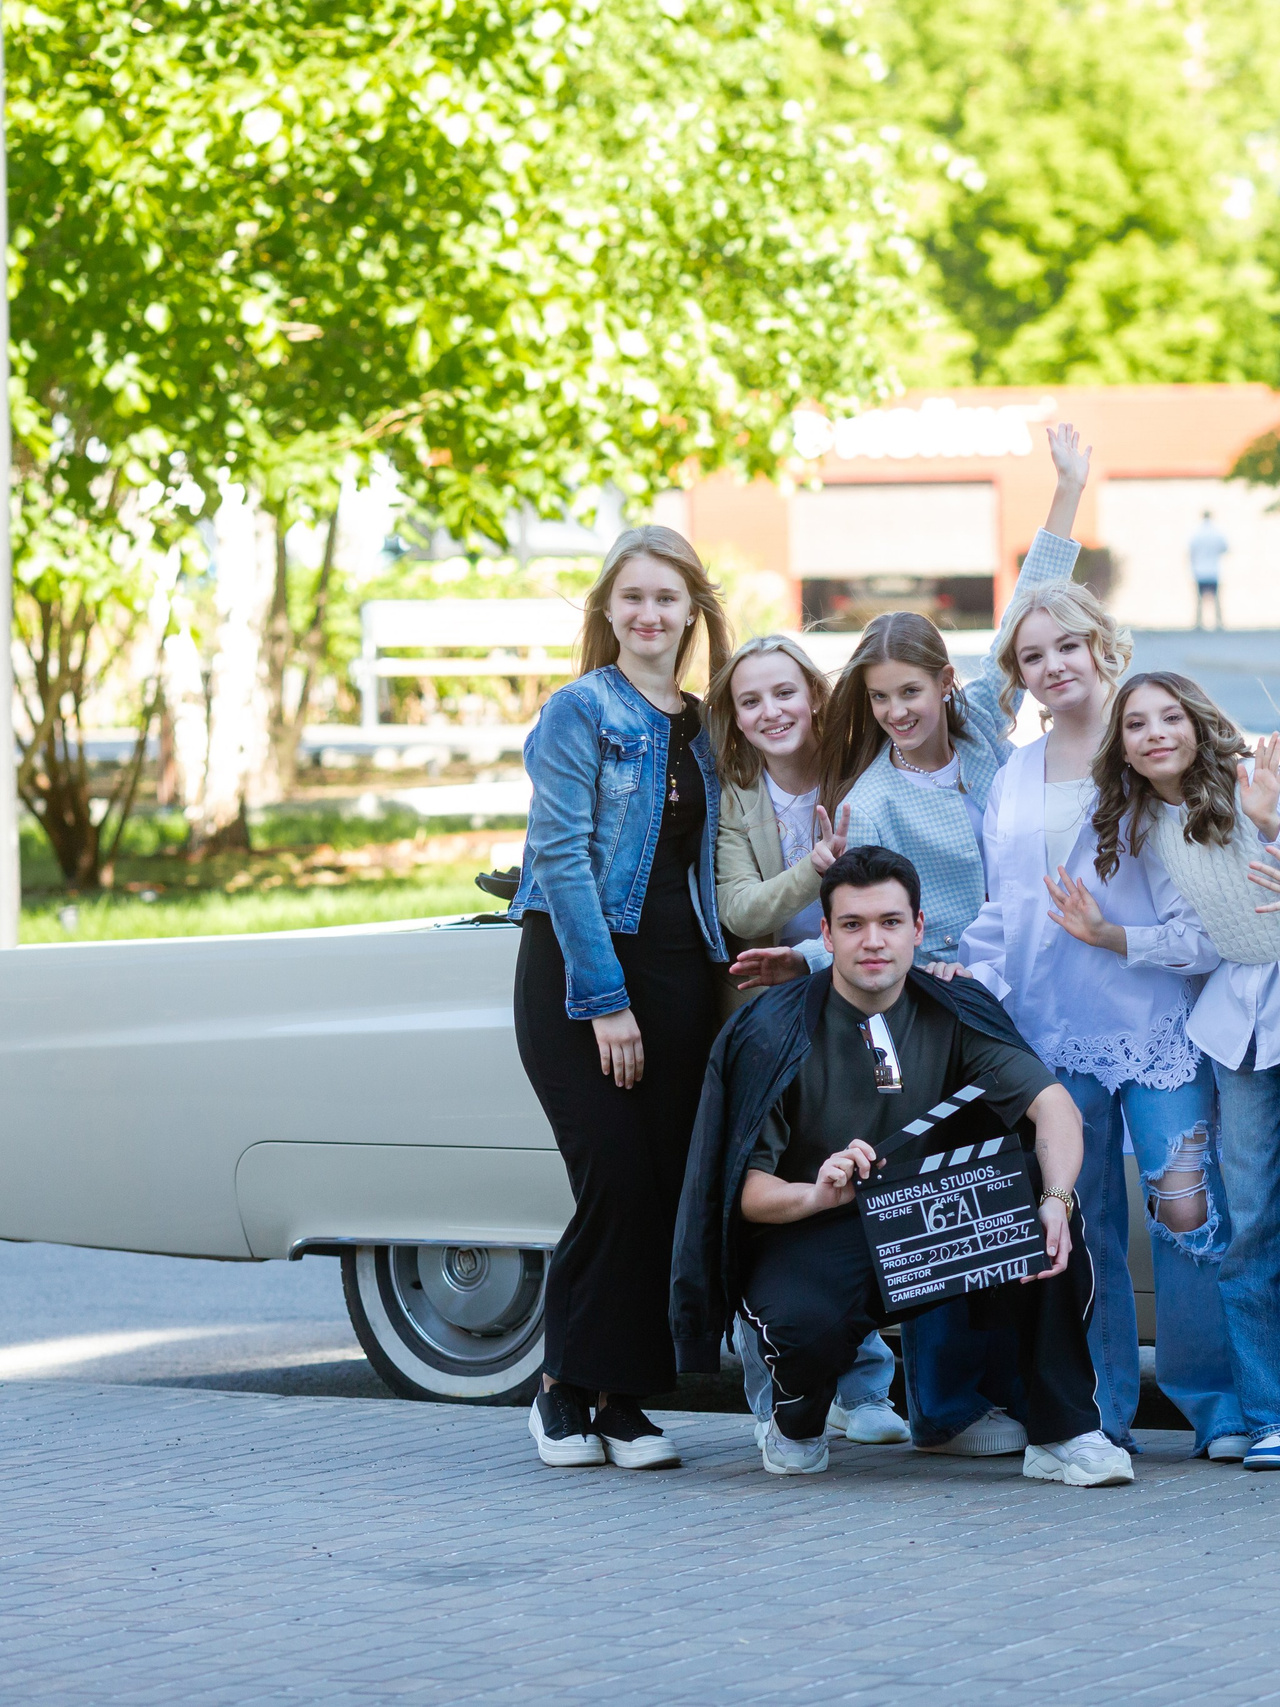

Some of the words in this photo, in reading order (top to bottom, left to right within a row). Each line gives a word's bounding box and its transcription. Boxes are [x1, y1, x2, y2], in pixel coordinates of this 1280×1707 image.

[867, 1182, 938, 1210] UNIVERSAL
[941, 1165, 995, 1190] STUDIOS
[987, 1179, 1013, 1192] ROLL
[934, 1193, 960, 1204] TAKE
[879, 1206, 913, 1221] SCENE
[978, 1214, 1014, 1231] SOUND
[986, 1225, 1029, 1249] 2024
[879, 1245, 901, 1257] DATE
[928, 1239, 972, 1265] 2023
[883, 1253, 924, 1270] PROD.CO.
[887, 1268, 931, 1287] DIRECTOR
[891, 1282, 945, 1303] CAMERAMAN
